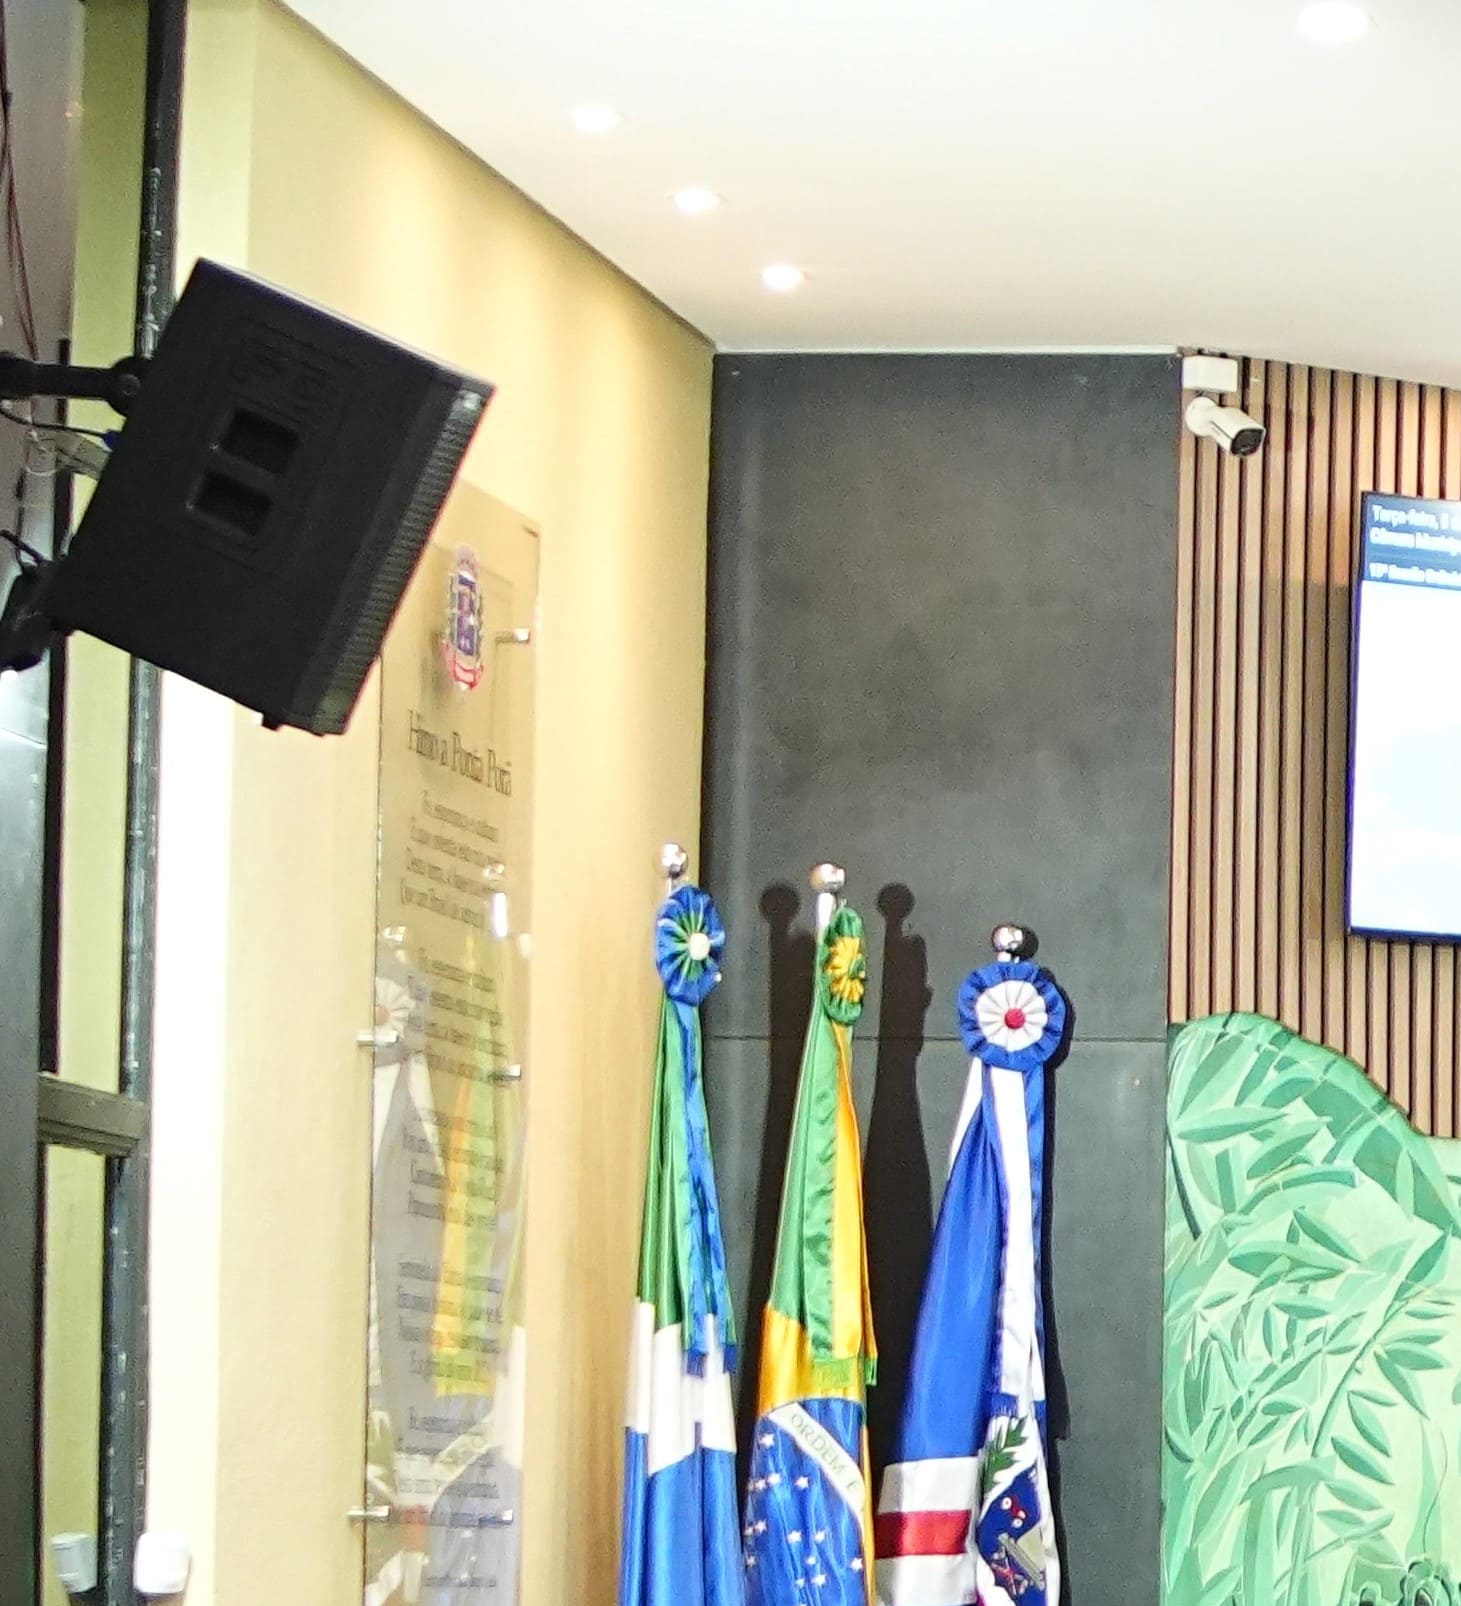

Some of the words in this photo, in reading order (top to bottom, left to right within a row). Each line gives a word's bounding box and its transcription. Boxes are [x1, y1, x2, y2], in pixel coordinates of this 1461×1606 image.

[452, 731, 484, 784] Ponta
[487, 749, 513, 797] Porã
[791, 1414, 846, 1475] ORDEM
